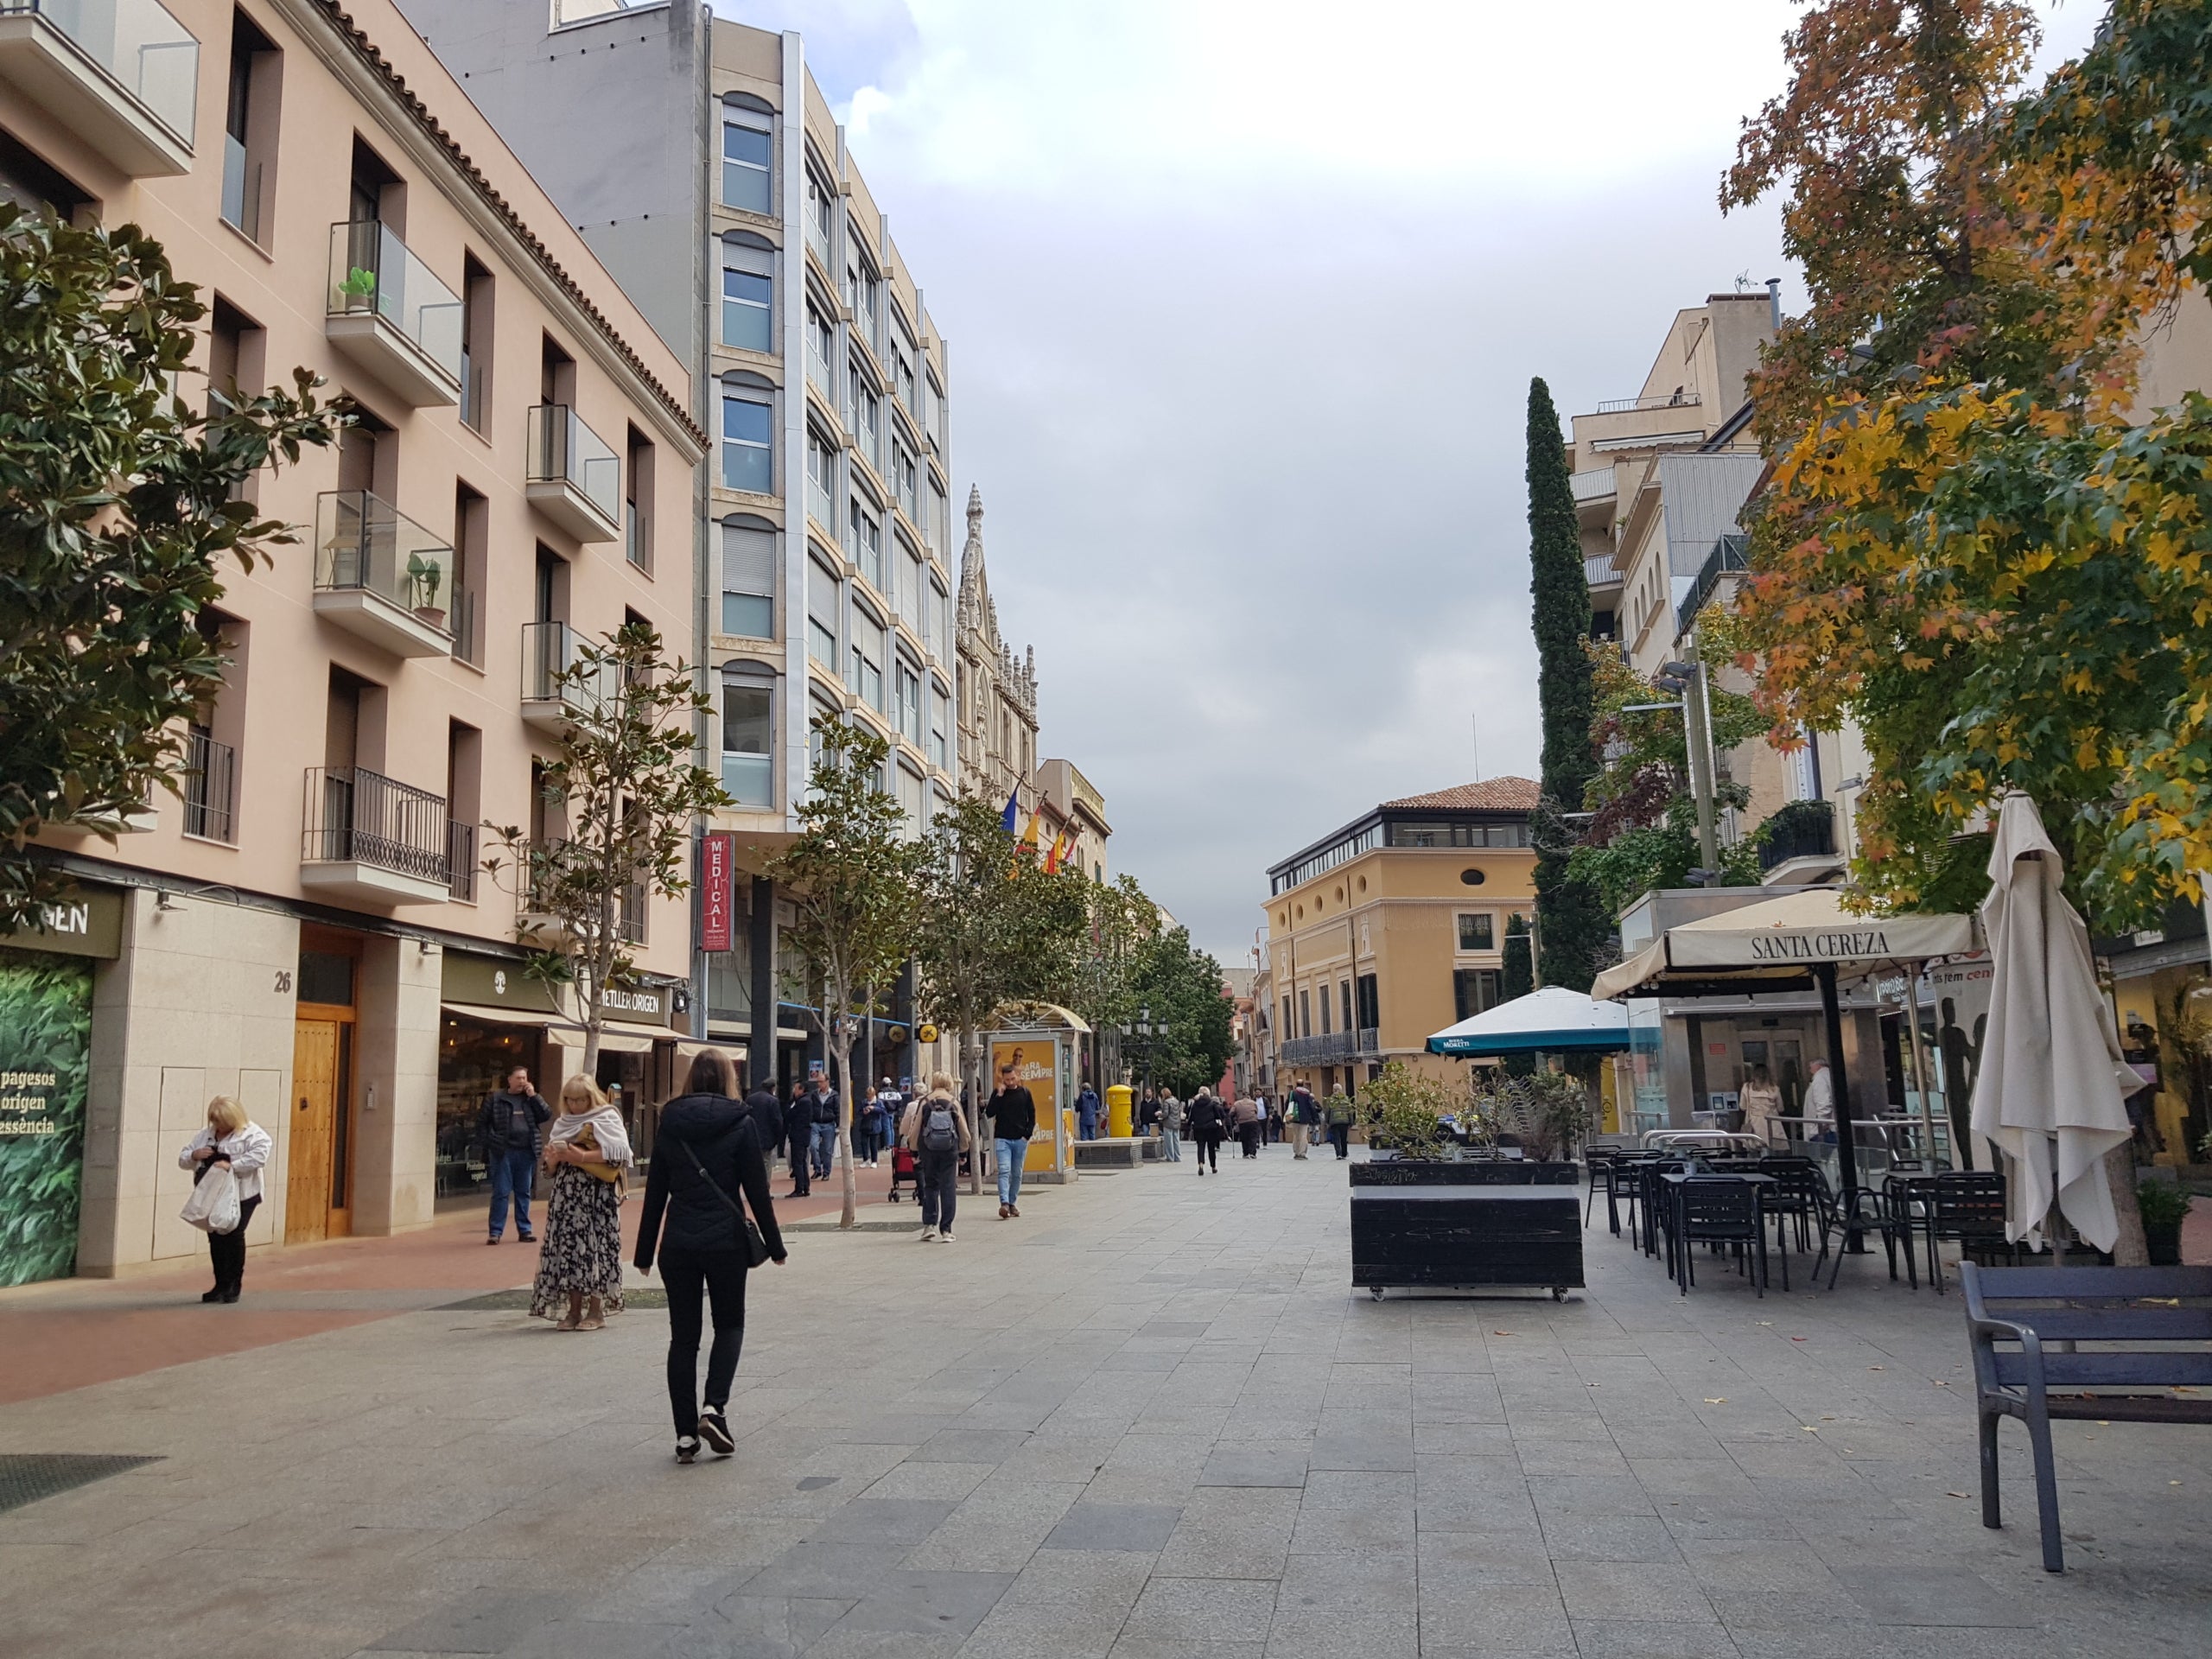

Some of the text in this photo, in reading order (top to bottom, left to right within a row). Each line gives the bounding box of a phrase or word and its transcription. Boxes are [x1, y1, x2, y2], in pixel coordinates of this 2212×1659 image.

[711, 841, 722, 928] MEDICAL
[1751, 931, 1891, 959] SANTA CEREZA
[273, 970, 291, 994] 26
[602, 988, 659, 1014] ETLLER ORIGEN
[0, 1071, 56, 1090] pagesos
[1020, 1067, 1053, 1080] SEMPRE
[0, 1091, 47, 1115] origen
